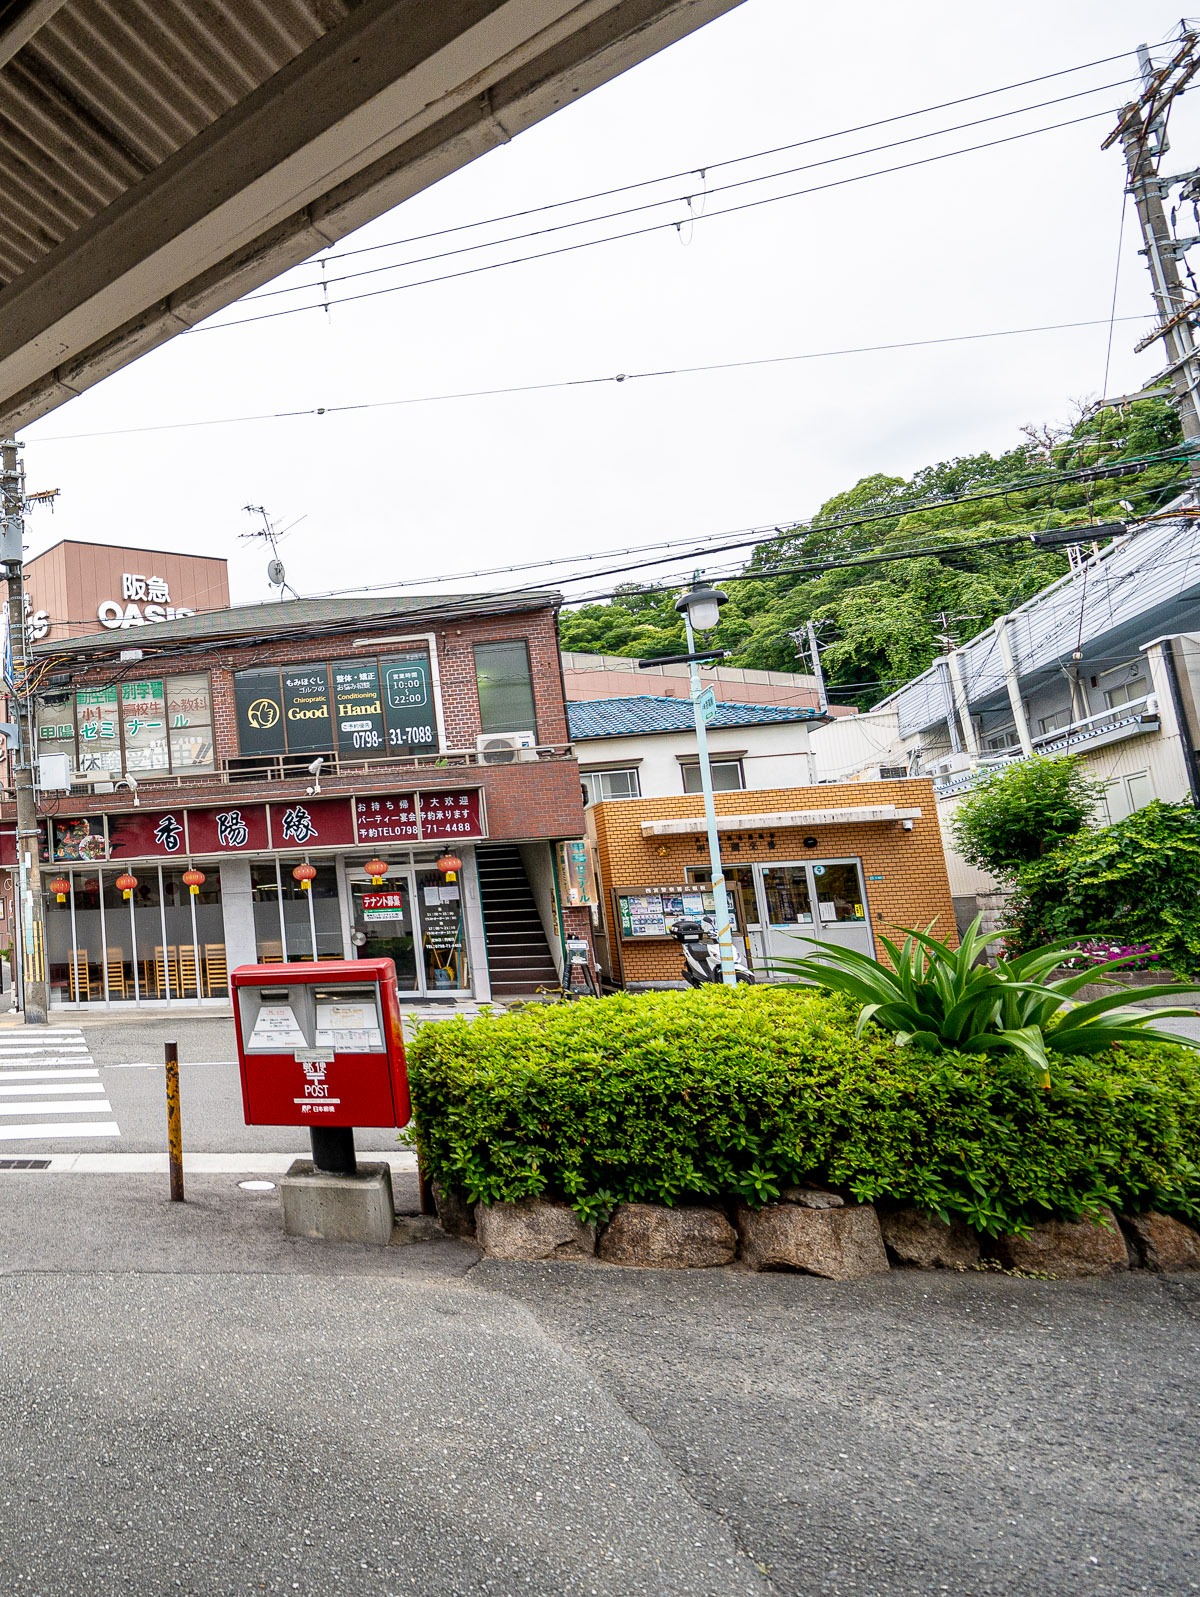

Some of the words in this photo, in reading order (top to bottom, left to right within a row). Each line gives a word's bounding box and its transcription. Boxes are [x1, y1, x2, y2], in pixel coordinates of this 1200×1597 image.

[121, 573, 170, 602] 阪急
[286, 677, 324, 687] もみほぐし
[335, 672, 376, 683] 整体・矯正
[392, 672, 418, 680] 営業時間
[298, 686, 325, 694] ゴルフの
[393, 680, 420, 689] 10:00
[337, 692, 377, 700] Conditioning
[394, 695, 421, 704] 22:00
[168, 697, 208, 712] 全教科
[287, 705, 329, 721] Good
[338, 701, 382, 717] Hand
[40, 714, 190, 740] 甲陽ゼミナール
[363, 895, 401, 908] テナント募集
[302, 1061, 327, 1074] 郵便
[304, 1084, 329, 1097] POST
